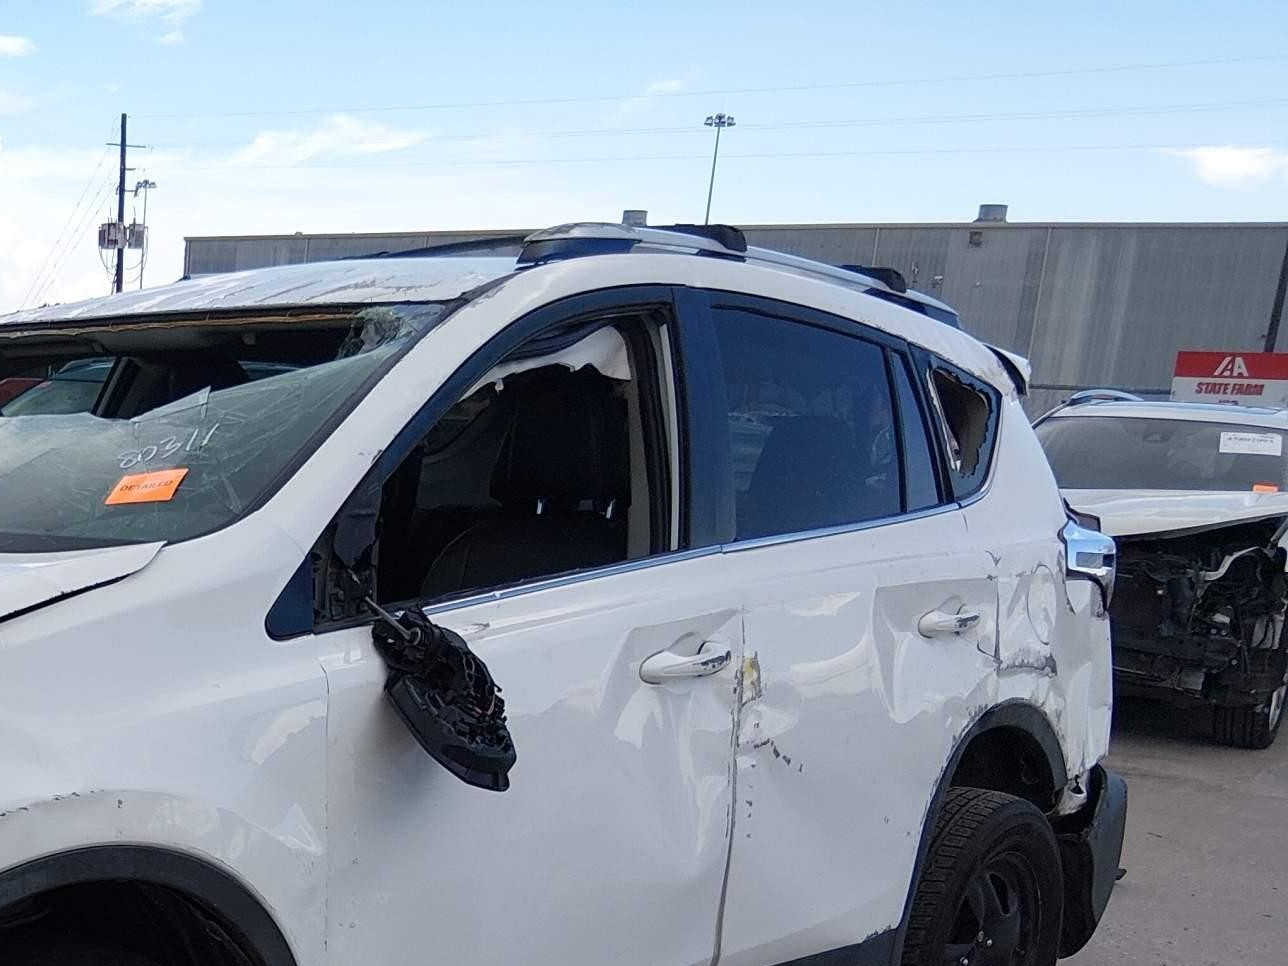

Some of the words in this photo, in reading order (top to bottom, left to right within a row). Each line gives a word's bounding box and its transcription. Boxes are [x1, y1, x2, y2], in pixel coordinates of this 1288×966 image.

[1195, 382, 1231, 395] STATE
[1232, 383, 1265, 396] FARM
[119, 480, 174, 492] DETAILED
